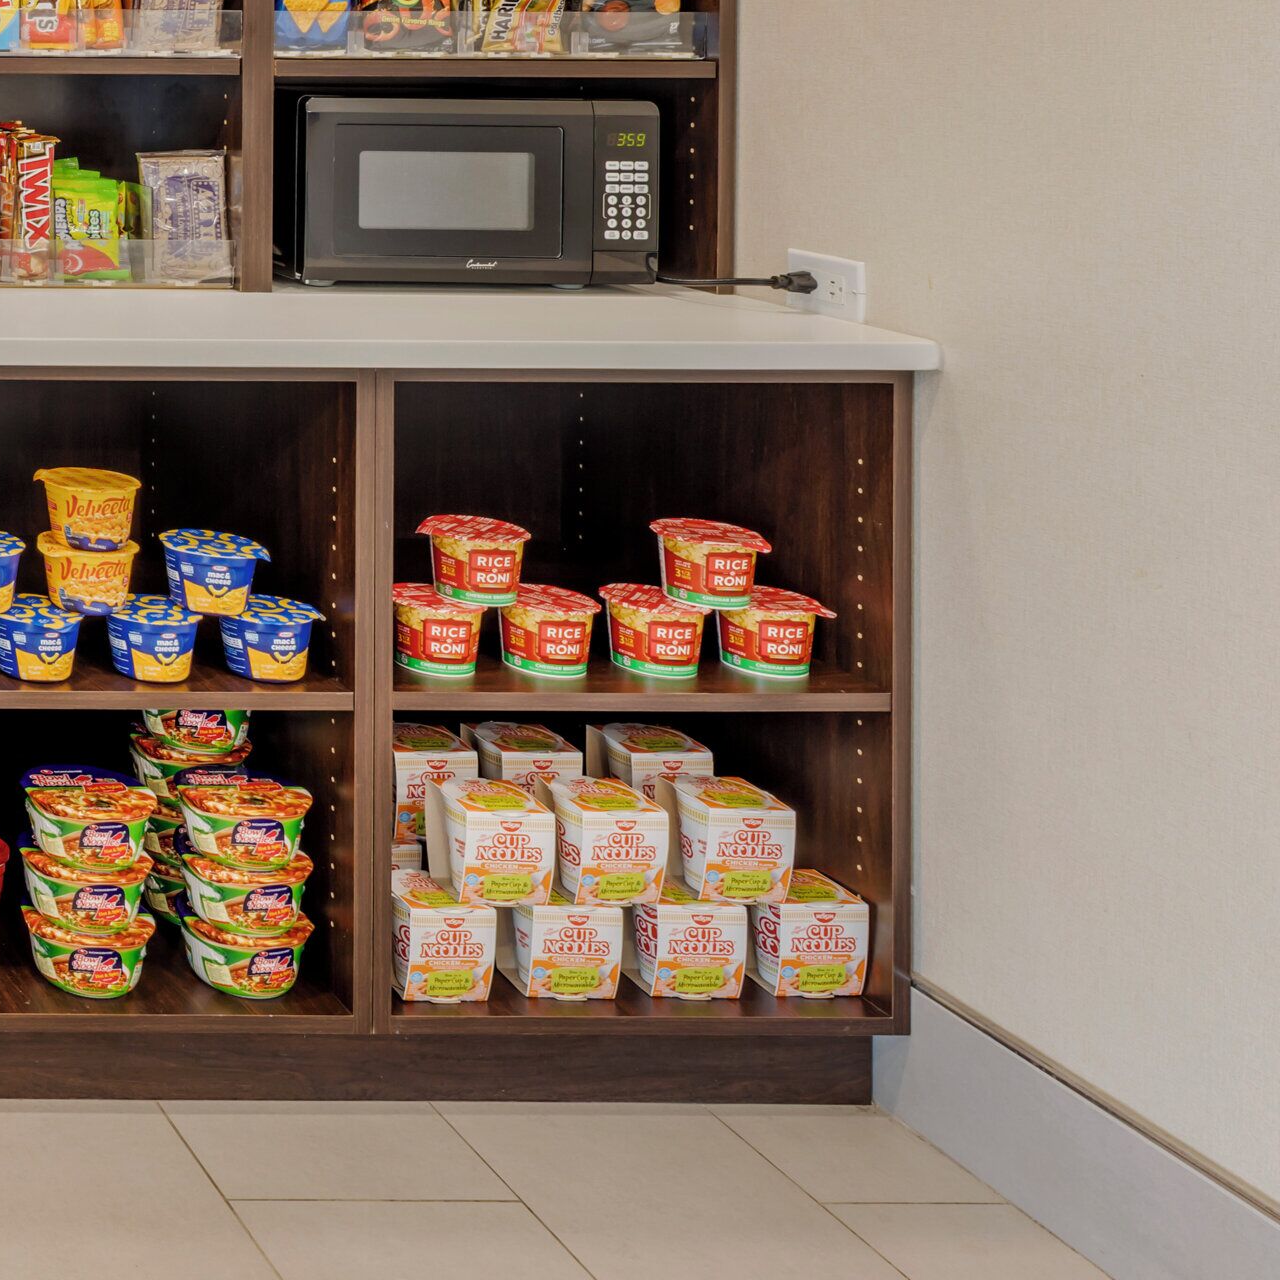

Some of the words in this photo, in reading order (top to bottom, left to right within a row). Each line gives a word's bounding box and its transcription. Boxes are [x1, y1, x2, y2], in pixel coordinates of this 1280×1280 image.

[617, 133, 646, 147] 359
[65, 494, 131, 518] Velveeta
[59, 559, 127, 581] Velveeta
[476, 556, 512, 570] RICE
[714, 557, 749, 572] RICE
[476, 571, 510, 584] RONI
[713, 574, 747, 587] RONI
[431, 625, 467, 639] RICE
[545, 626, 582, 639] RICE
[656, 626, 693, 639] RICE
[767, 626, 804, 639] RICE
[430, 641, 466, 655] RONI
[545, 642, 581, 656] RONI
[655, 642, 691, 656] RONI
[766, 642, 803, 655] RONI
[492, 834, 530, 848] CUP
[607, 833, 645, 848] CUP
[734, 831, 770, 844] CUP
[476, 847, 542, 863] NOODLES
[592, 846, 656, 862] NOODLES
[717, 843, 782, 859] NOODLES
[436, 930, 471, 945] CUP
[559, 927, 597, 941] CUP
[684, 927, 722, 941] CUP
[806, 925, 844, 938] CUP
[420, 943, 484, 958] NOODLES
[543, 940, 609, 955] NOODLES
[668, 939, 734, 955] NOODLES
[791, 937, 856, 953] NOODLES
